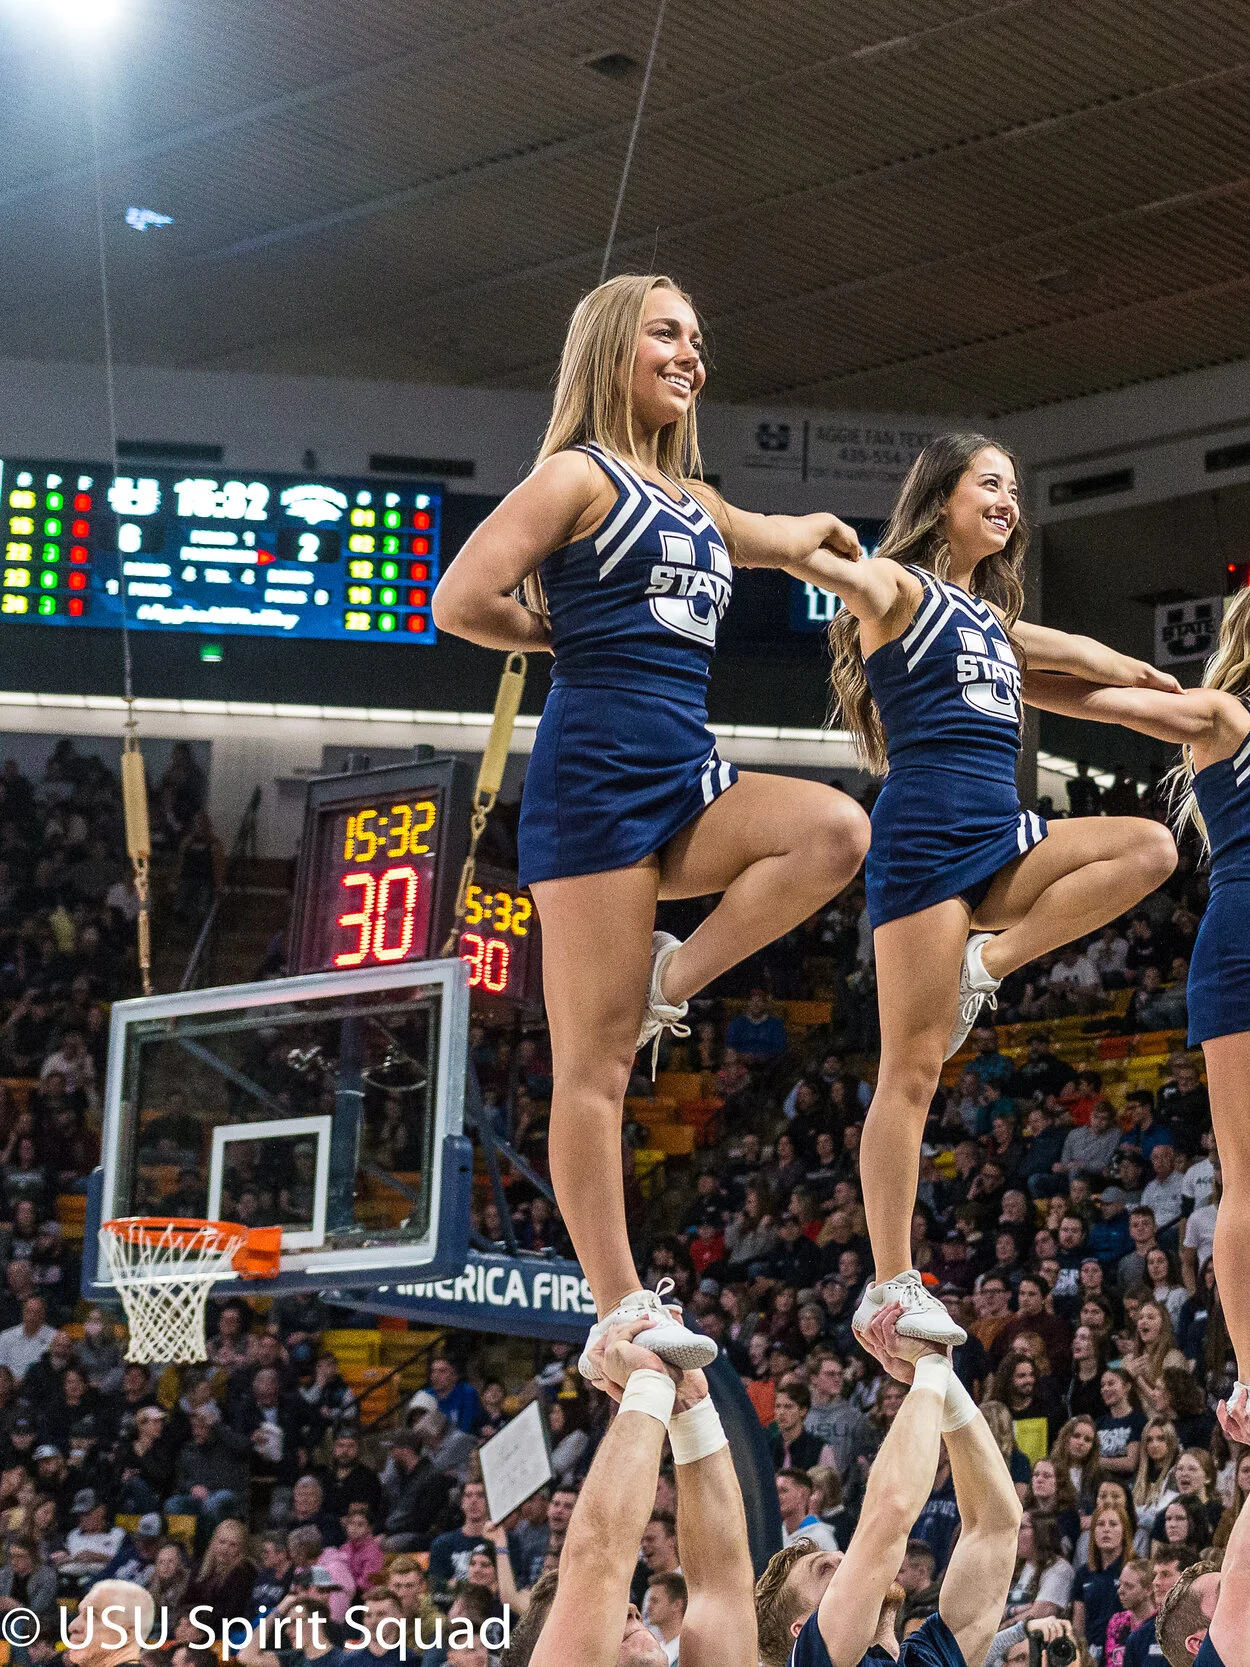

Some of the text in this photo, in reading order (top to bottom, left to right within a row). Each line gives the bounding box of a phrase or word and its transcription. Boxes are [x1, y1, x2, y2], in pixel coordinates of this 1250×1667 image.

[815, 427, 860, 444] AGGIE
[865, 429, 894, 445] FAN
[297, 532, 320, 562] 2
[645, 565, 732, 620] STATE
[1162, 617, 1216, 642] STATE
[957, 654, 1021, 702] STATE
[344, 801, 436, 862] 15:32
[333, 864, 418, 968] 30
[461, 932, 509, 992] 30
